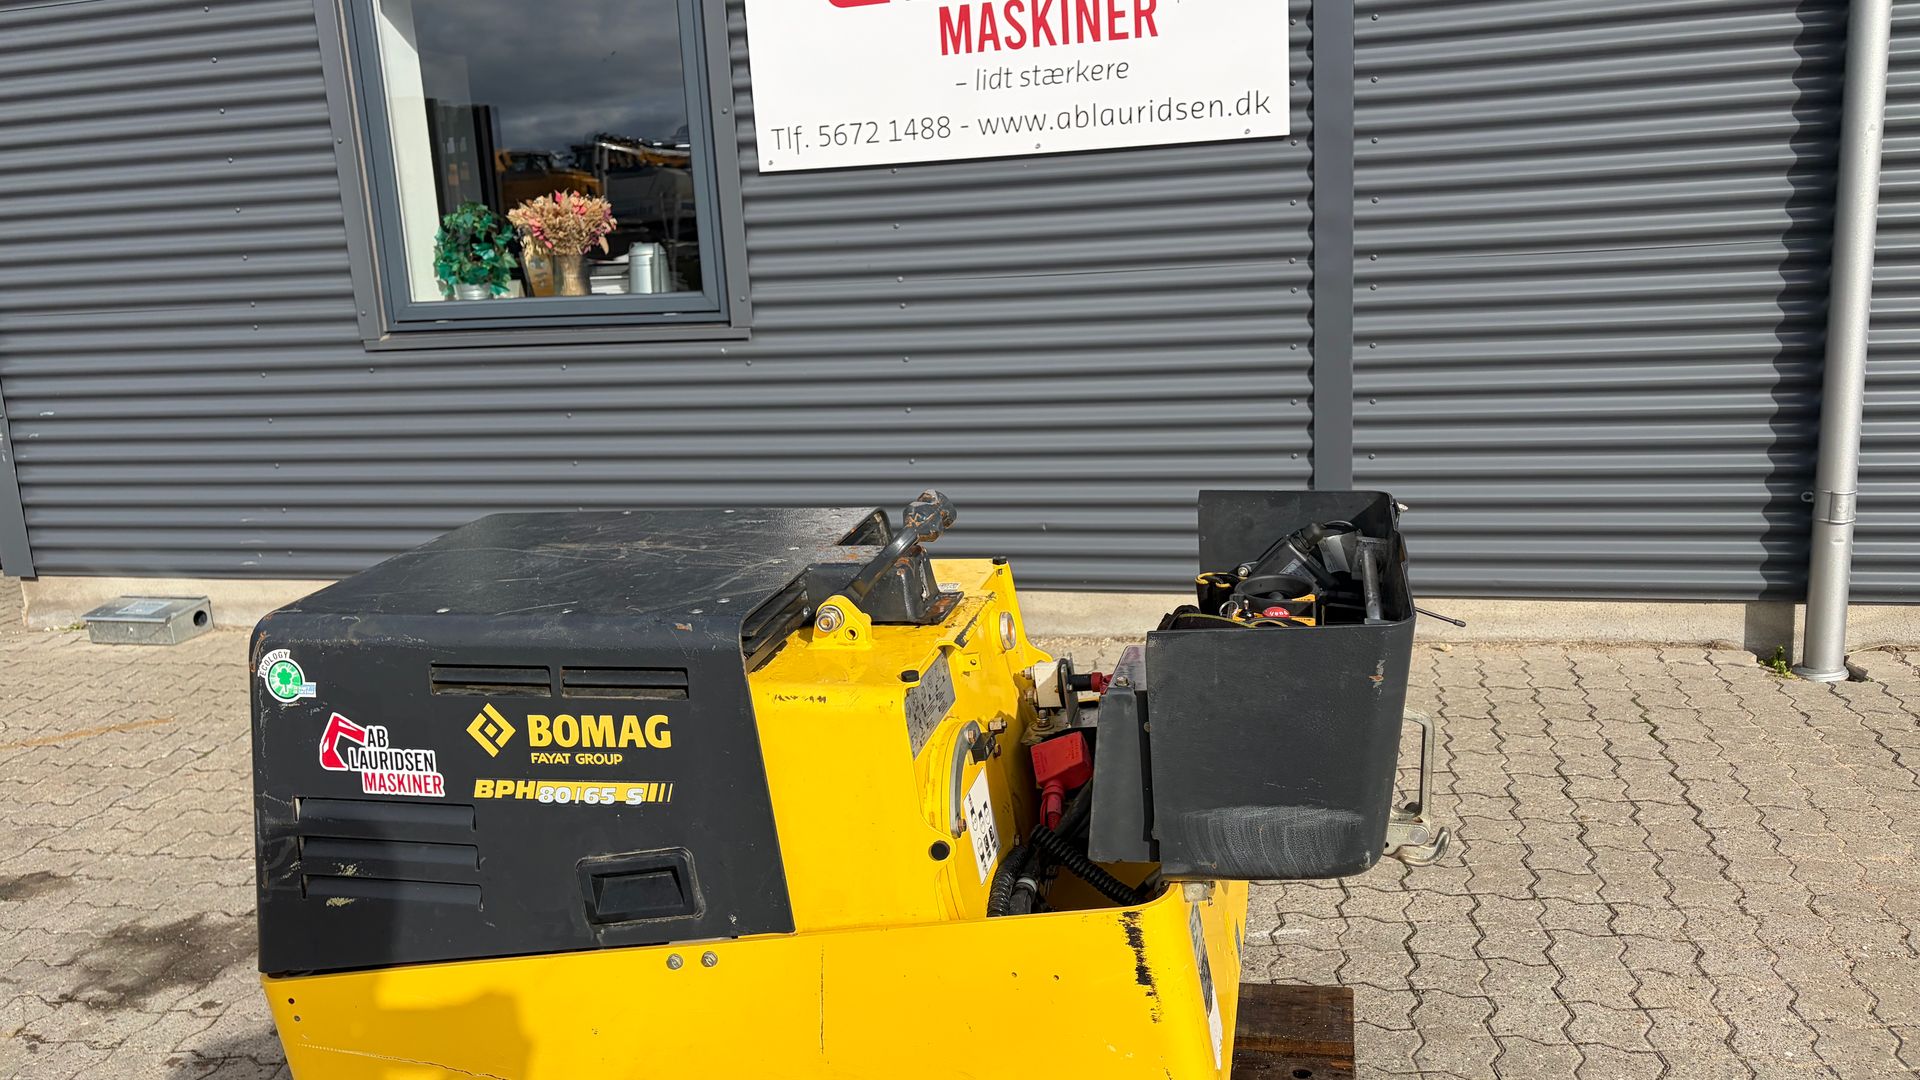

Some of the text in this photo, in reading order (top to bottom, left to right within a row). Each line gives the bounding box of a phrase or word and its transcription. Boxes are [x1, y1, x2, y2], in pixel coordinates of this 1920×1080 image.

[939, 0, 1158, 56] MASKINER
[976, 66, 1012, 91] lidt
[1020, 60, 1129, 87] stærkere
[771, 126, 809, 155] Tlf.
[818, 121, 880, 147] 5672
[888, 116, 951, 142] 1488
[977, 91, 1271, 135] www.ablauridsen.dk
[259, 651, 288, 676] ECOLOGY
[367, 729, 387, 748] AB
[528, 714, 672, 748] BOMAG
[350, 749, 434, 772] LAURIDSEN
[531, 753, 623, 765] FAYAT GROUP
[364, 773, 443, 795] MASKINER
